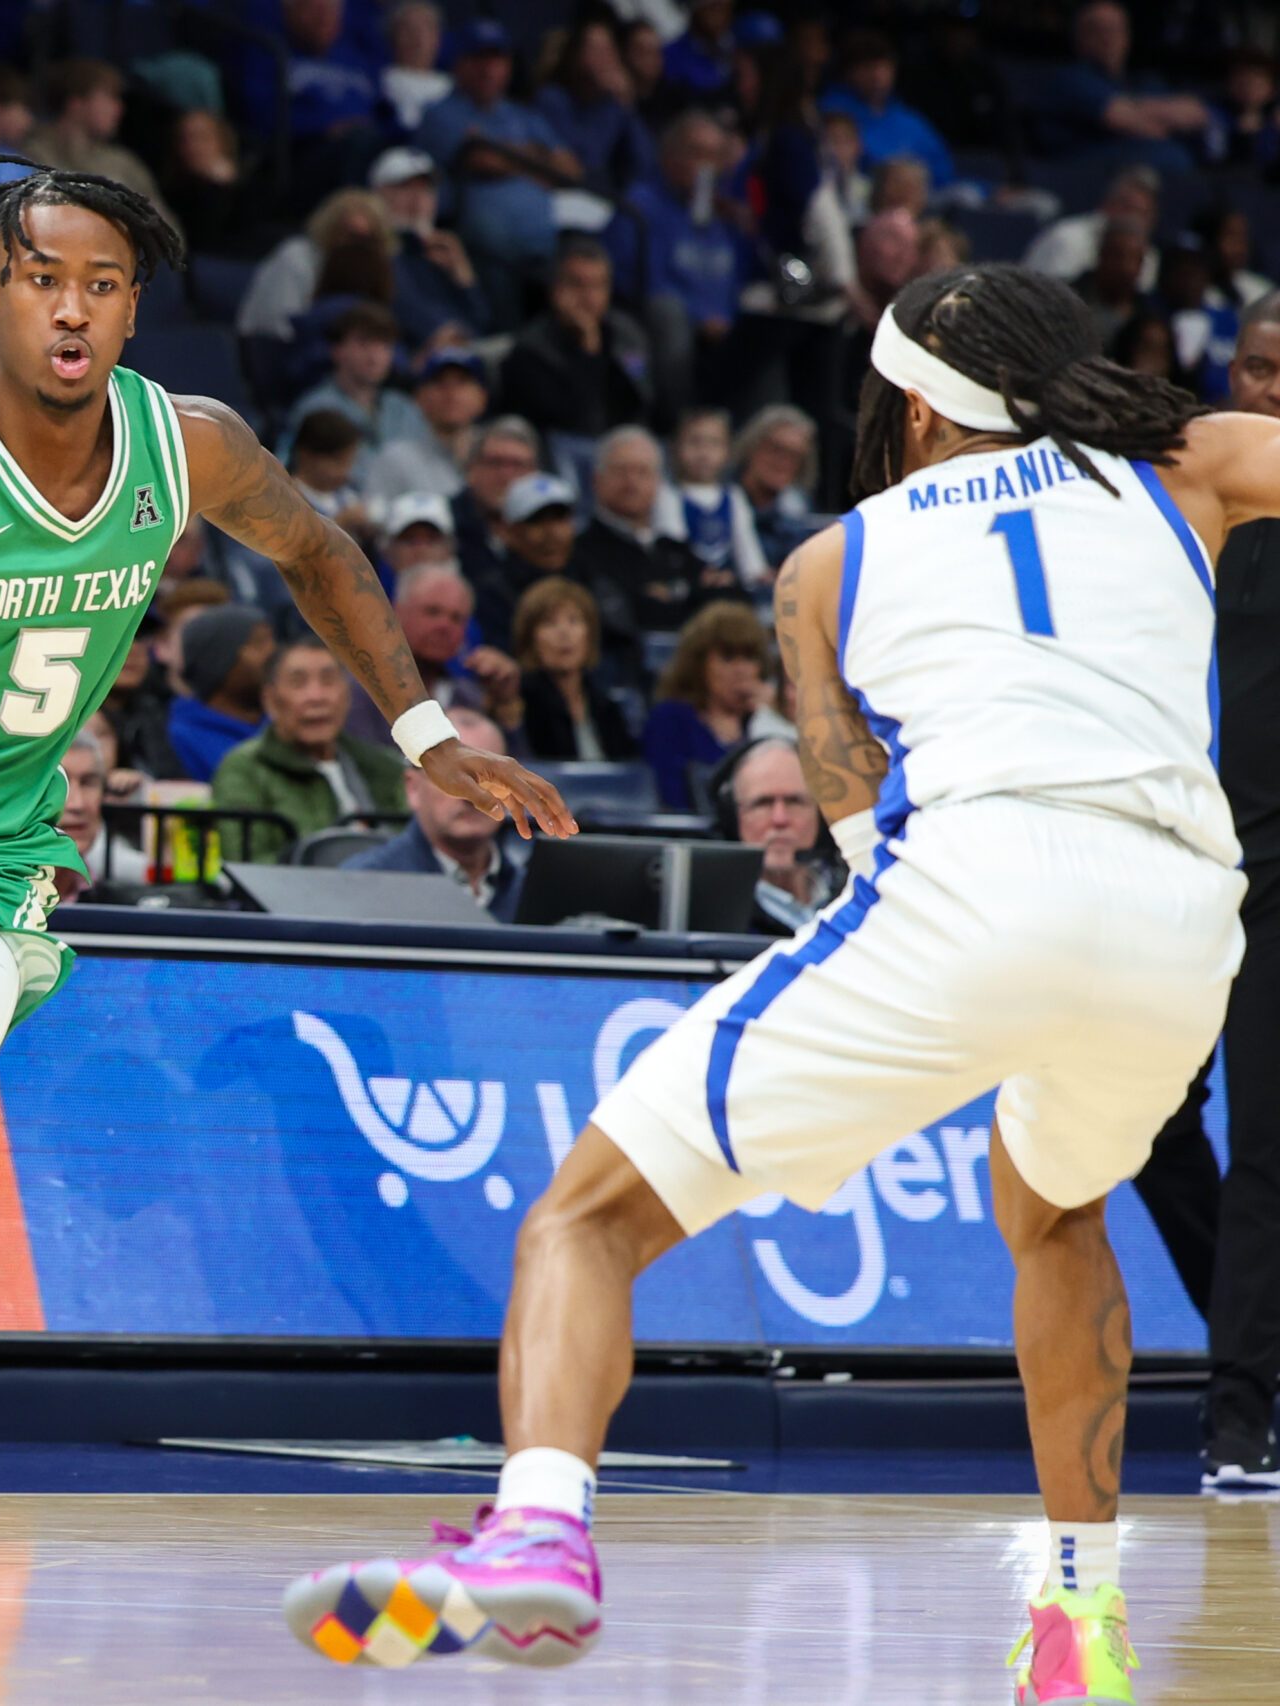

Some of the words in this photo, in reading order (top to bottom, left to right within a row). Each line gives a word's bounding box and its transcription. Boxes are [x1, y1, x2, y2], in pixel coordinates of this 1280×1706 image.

[908, 449, 1091, 512] McDANIE
[70, 560, 156, 613] TEXAS
[986, 508, 1058, 639] 1
